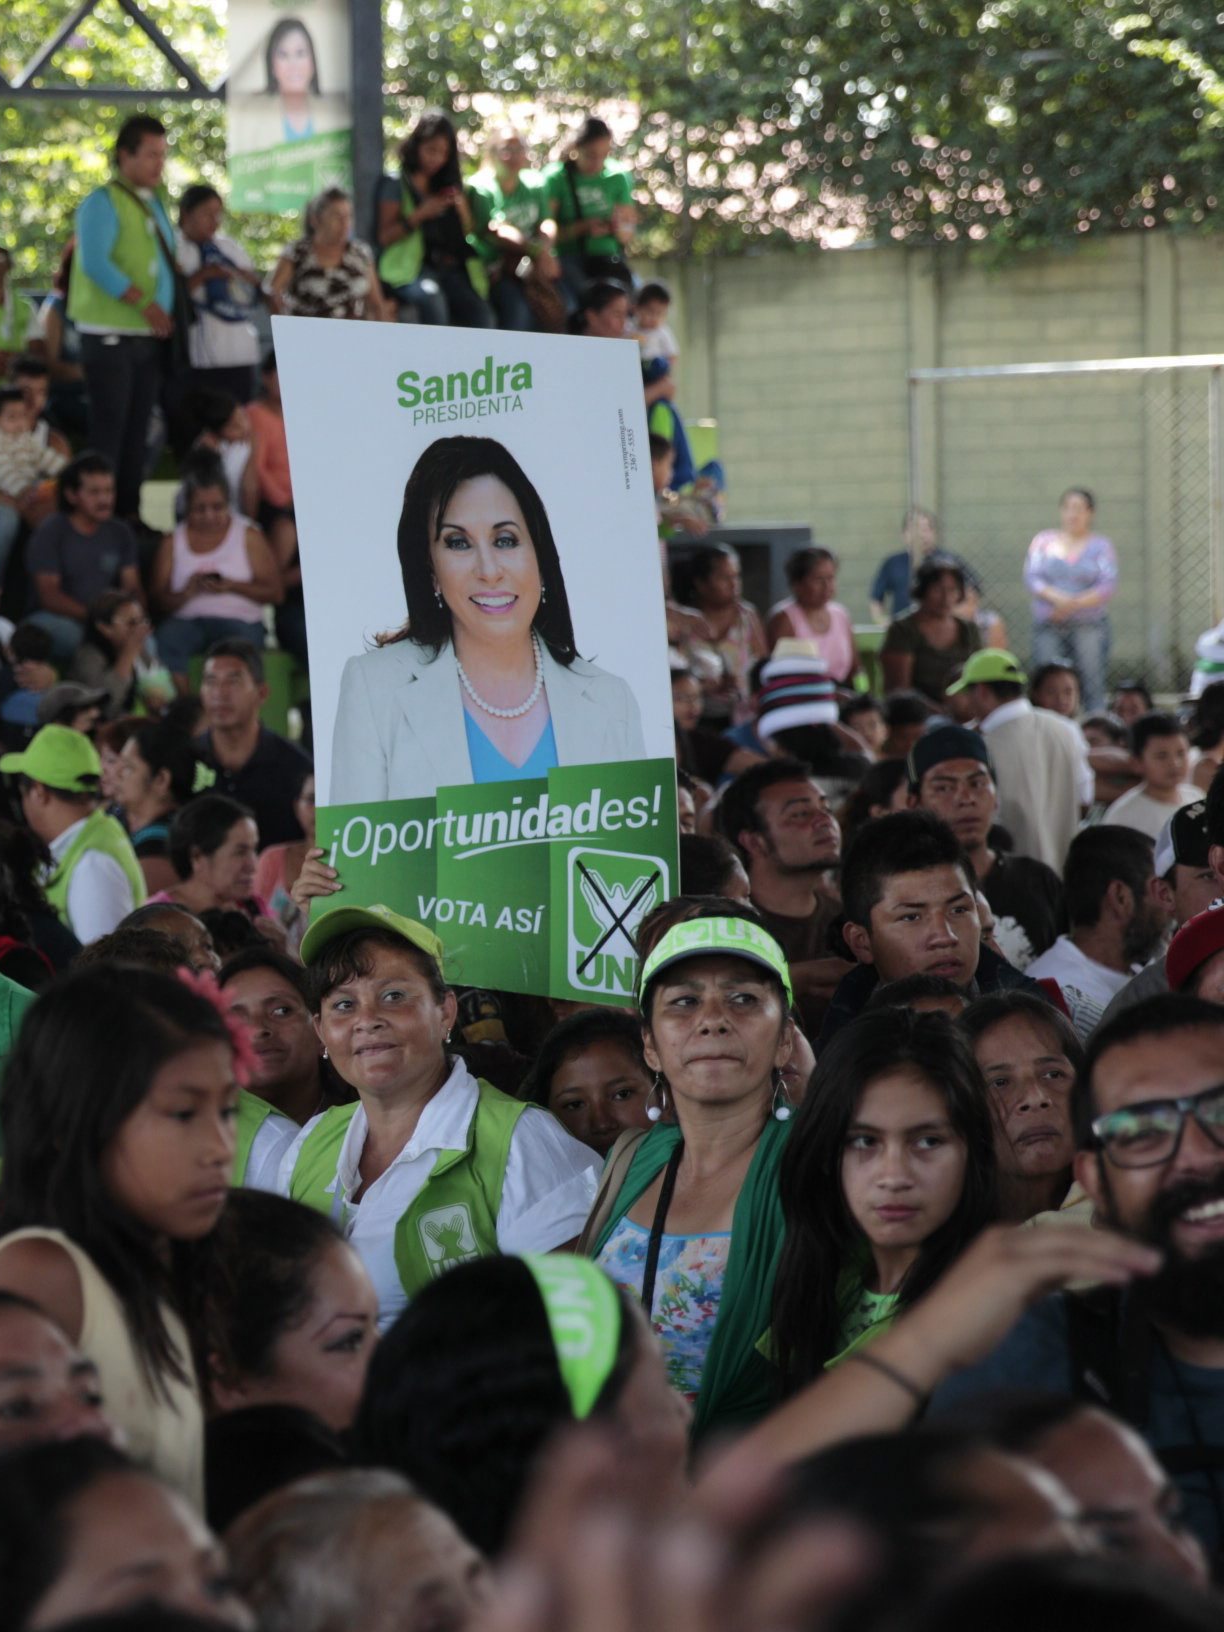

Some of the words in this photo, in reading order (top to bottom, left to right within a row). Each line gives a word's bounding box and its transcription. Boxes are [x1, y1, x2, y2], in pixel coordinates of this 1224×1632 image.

[396, 355, 533, 408] Sandra
[412, 395, 524, 427] PRESIDENTA
[629, 453, 638, 472] 2367
[328, 785, 662, 869] ¡Oportunidades!
[417, 895, 488, 928] VOTA
[494, 905, 547, 935] ASÍ
[576, 950, 638, 993] UN
